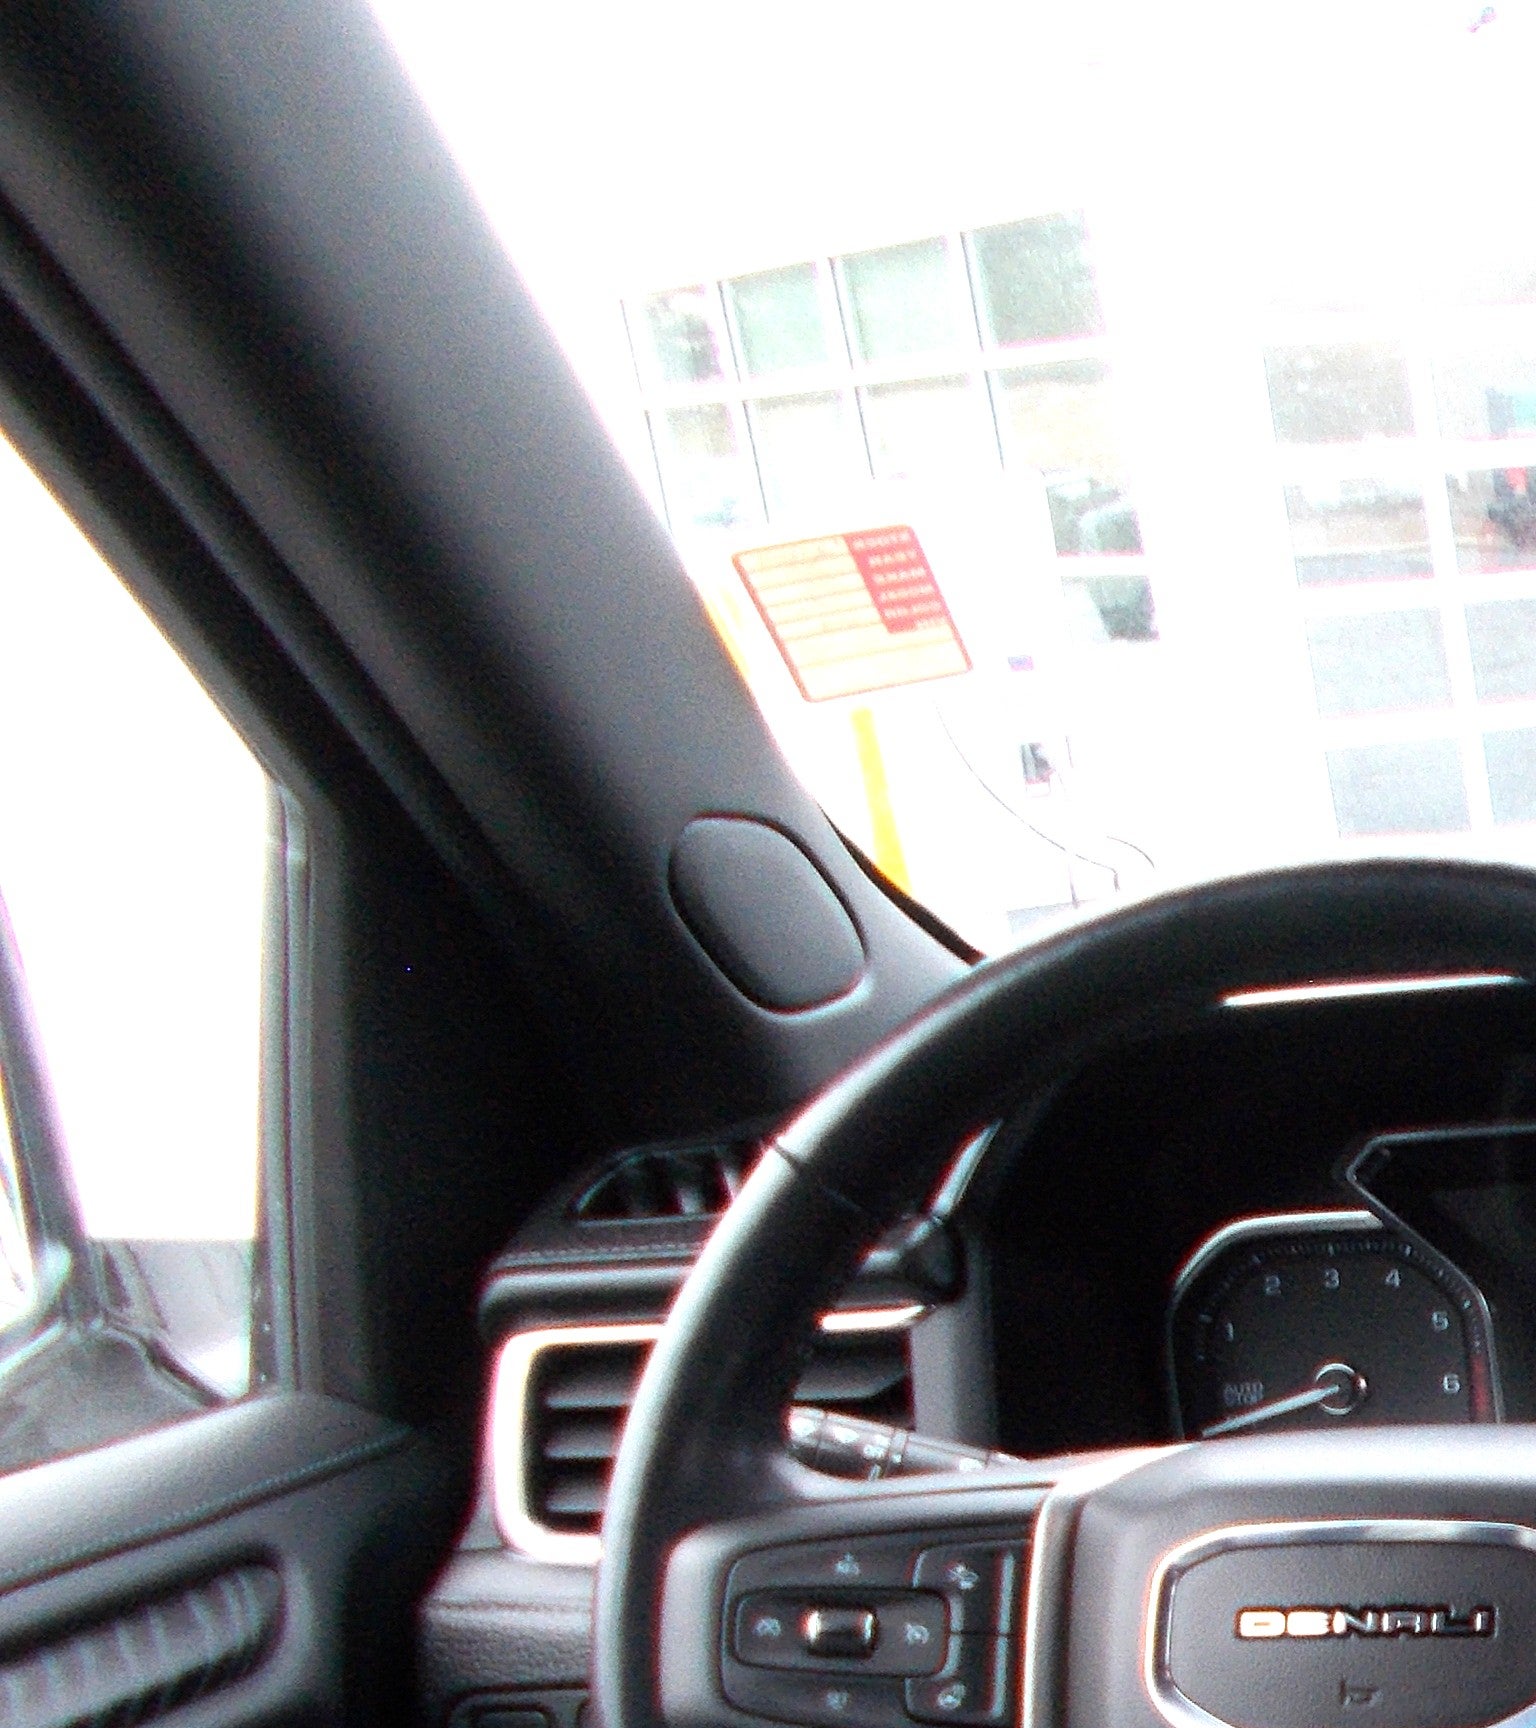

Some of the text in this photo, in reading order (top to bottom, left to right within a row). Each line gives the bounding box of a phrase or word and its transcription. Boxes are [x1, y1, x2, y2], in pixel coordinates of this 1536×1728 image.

[1264, 1273, 1283, 1296] 2
[1322, 1266, 1341, 1290] 3
[1385, 1267, 1401, 1290] 4
[1431, 1308, 1451, 1332] 5
[1442, 1372, 1462, 1395] 6
[1235, 1605, 1496, 1639] DENALI
